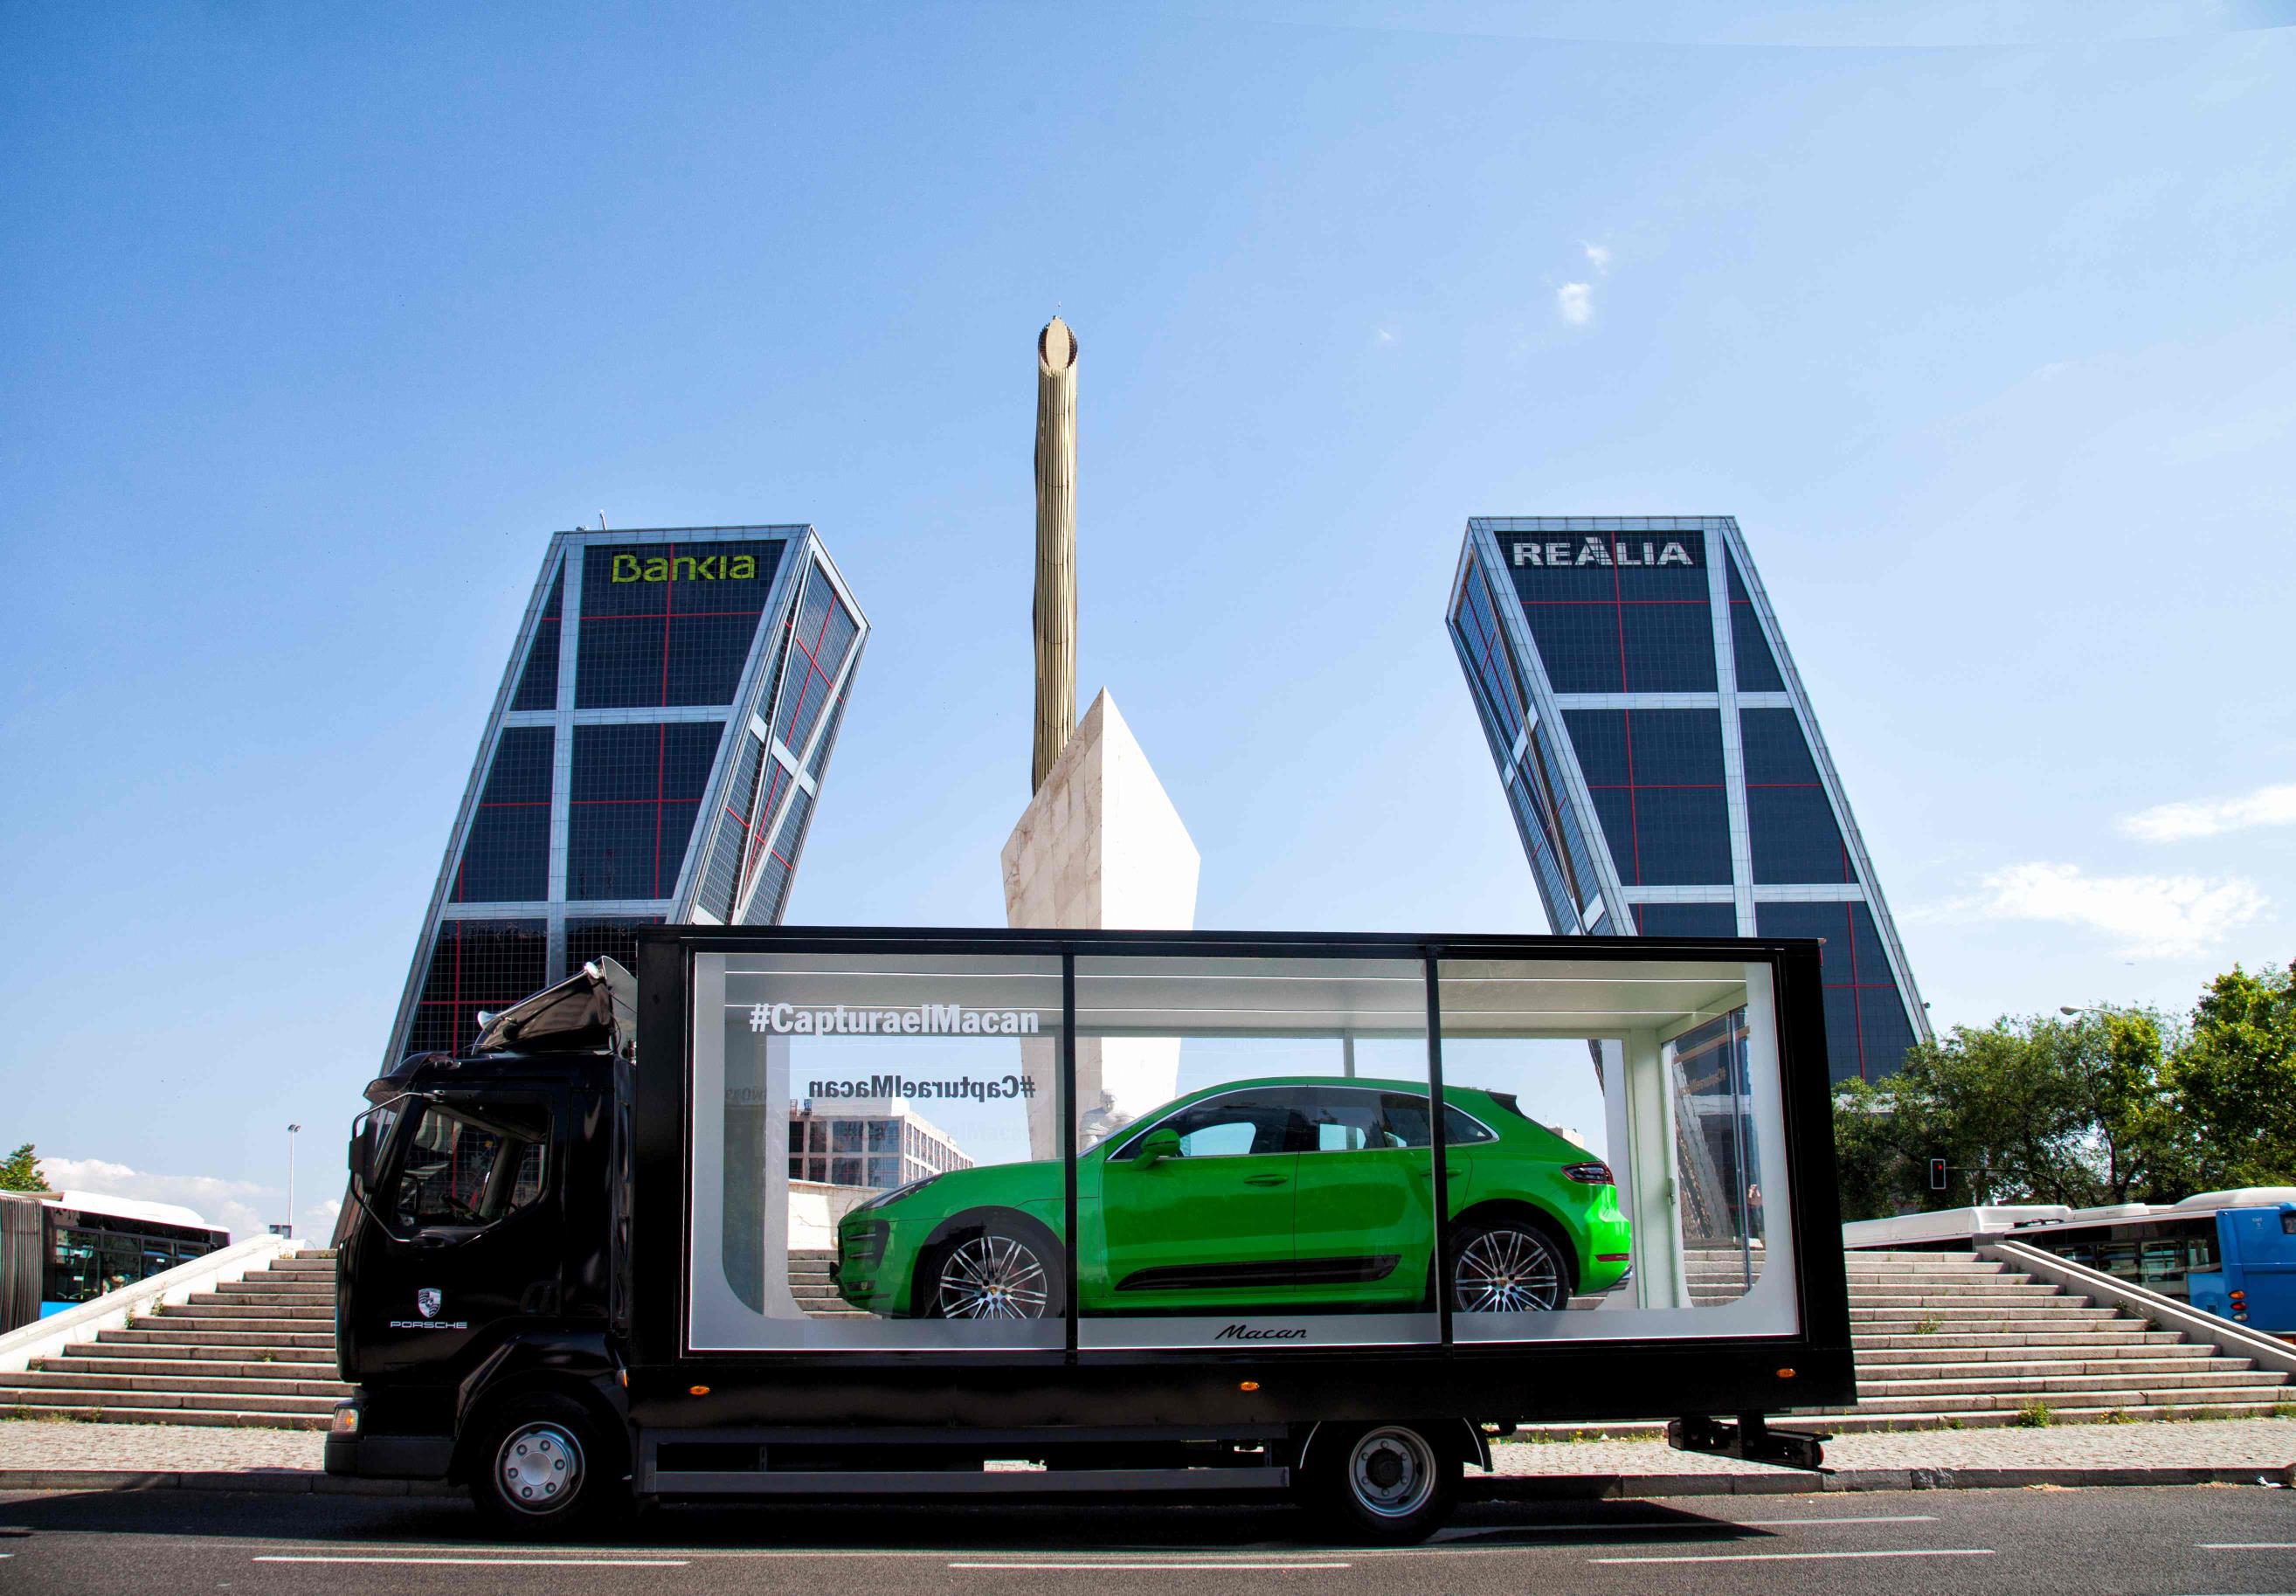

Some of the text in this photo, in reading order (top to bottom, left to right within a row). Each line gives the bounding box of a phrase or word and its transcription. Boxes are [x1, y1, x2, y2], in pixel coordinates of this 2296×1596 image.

[1513, 536, 1694, 566] REALIA
[612, 554, 755, 584] Bankia
[749, 1003, 1040, 1037] #CapturaelMacan
[1214, 1324, 1307, 1340] Macan
